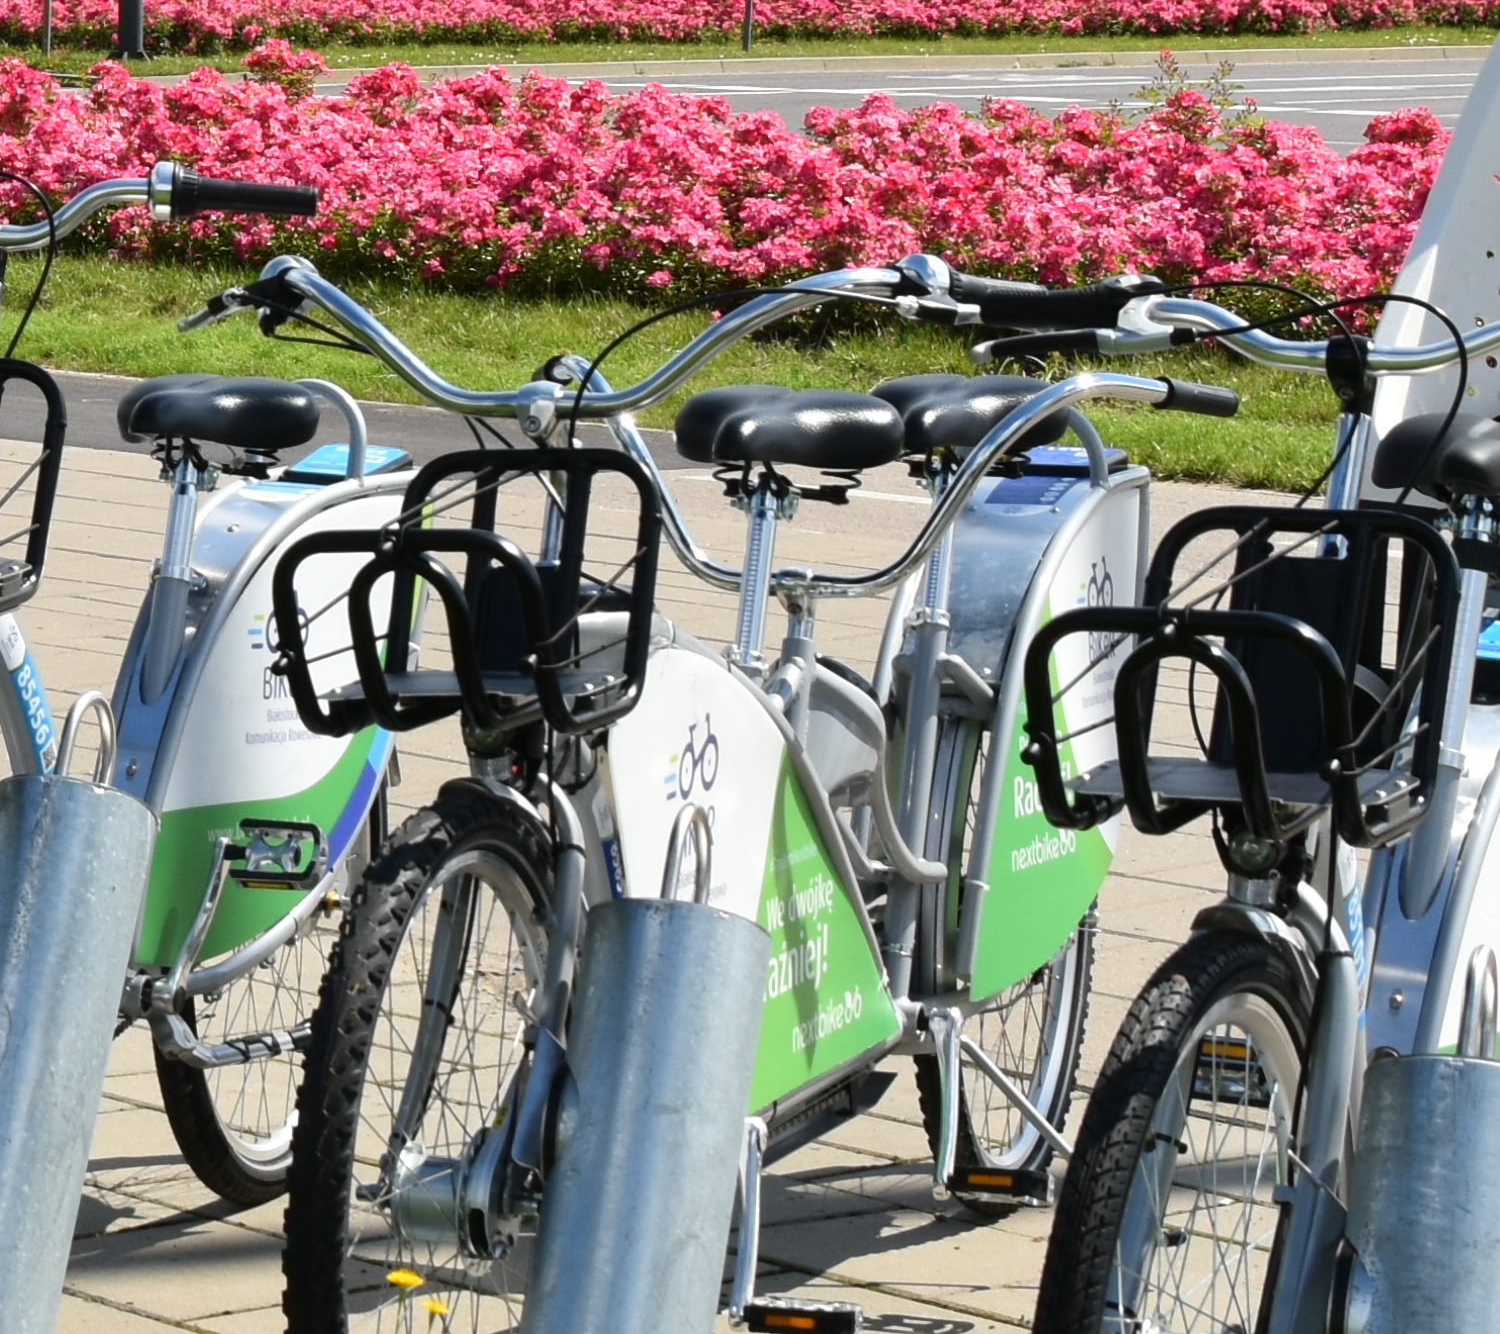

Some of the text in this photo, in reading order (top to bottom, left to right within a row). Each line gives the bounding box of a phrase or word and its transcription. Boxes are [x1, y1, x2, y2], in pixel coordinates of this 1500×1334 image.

[17, 663, 49, 745] 85456
[1011, 831, 1060, 872] nextbike
[765, 873, 835, 931] We dwójkę
[792, 997, 844, 1053] nextbike
